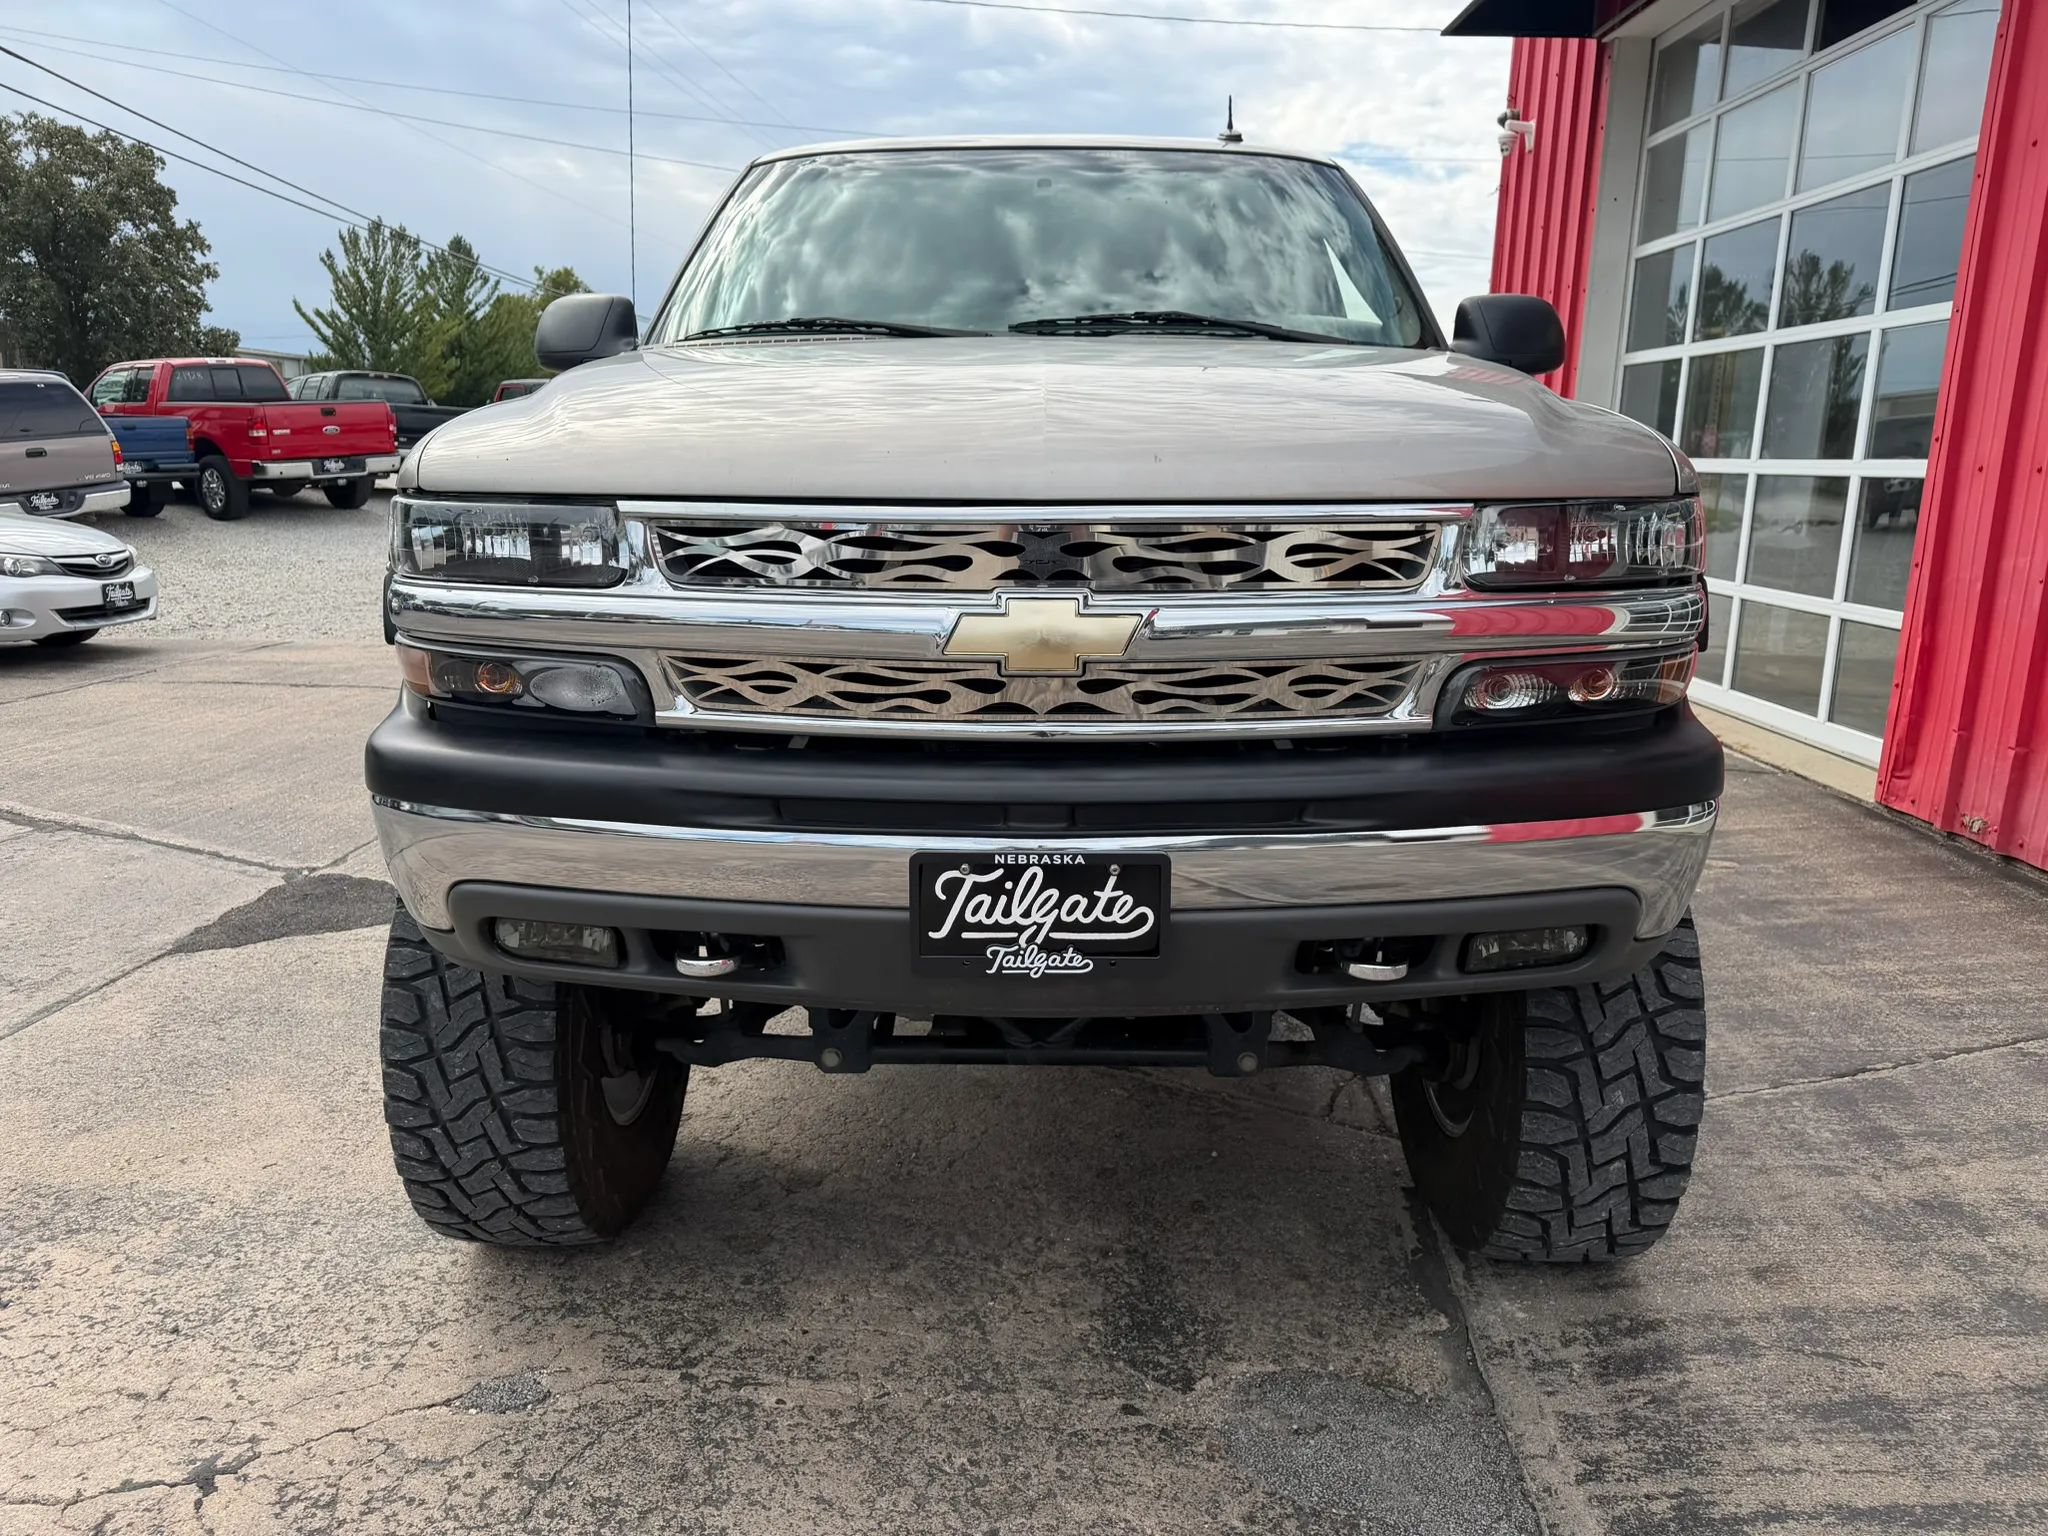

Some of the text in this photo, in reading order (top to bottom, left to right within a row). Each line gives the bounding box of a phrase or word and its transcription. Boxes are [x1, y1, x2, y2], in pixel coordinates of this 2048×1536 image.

[994, 854, 1086, 865] NEBRASKA
[928, 866, 1155, 948] Tailgate
[986, 945, 1094, 978] Tailgate
